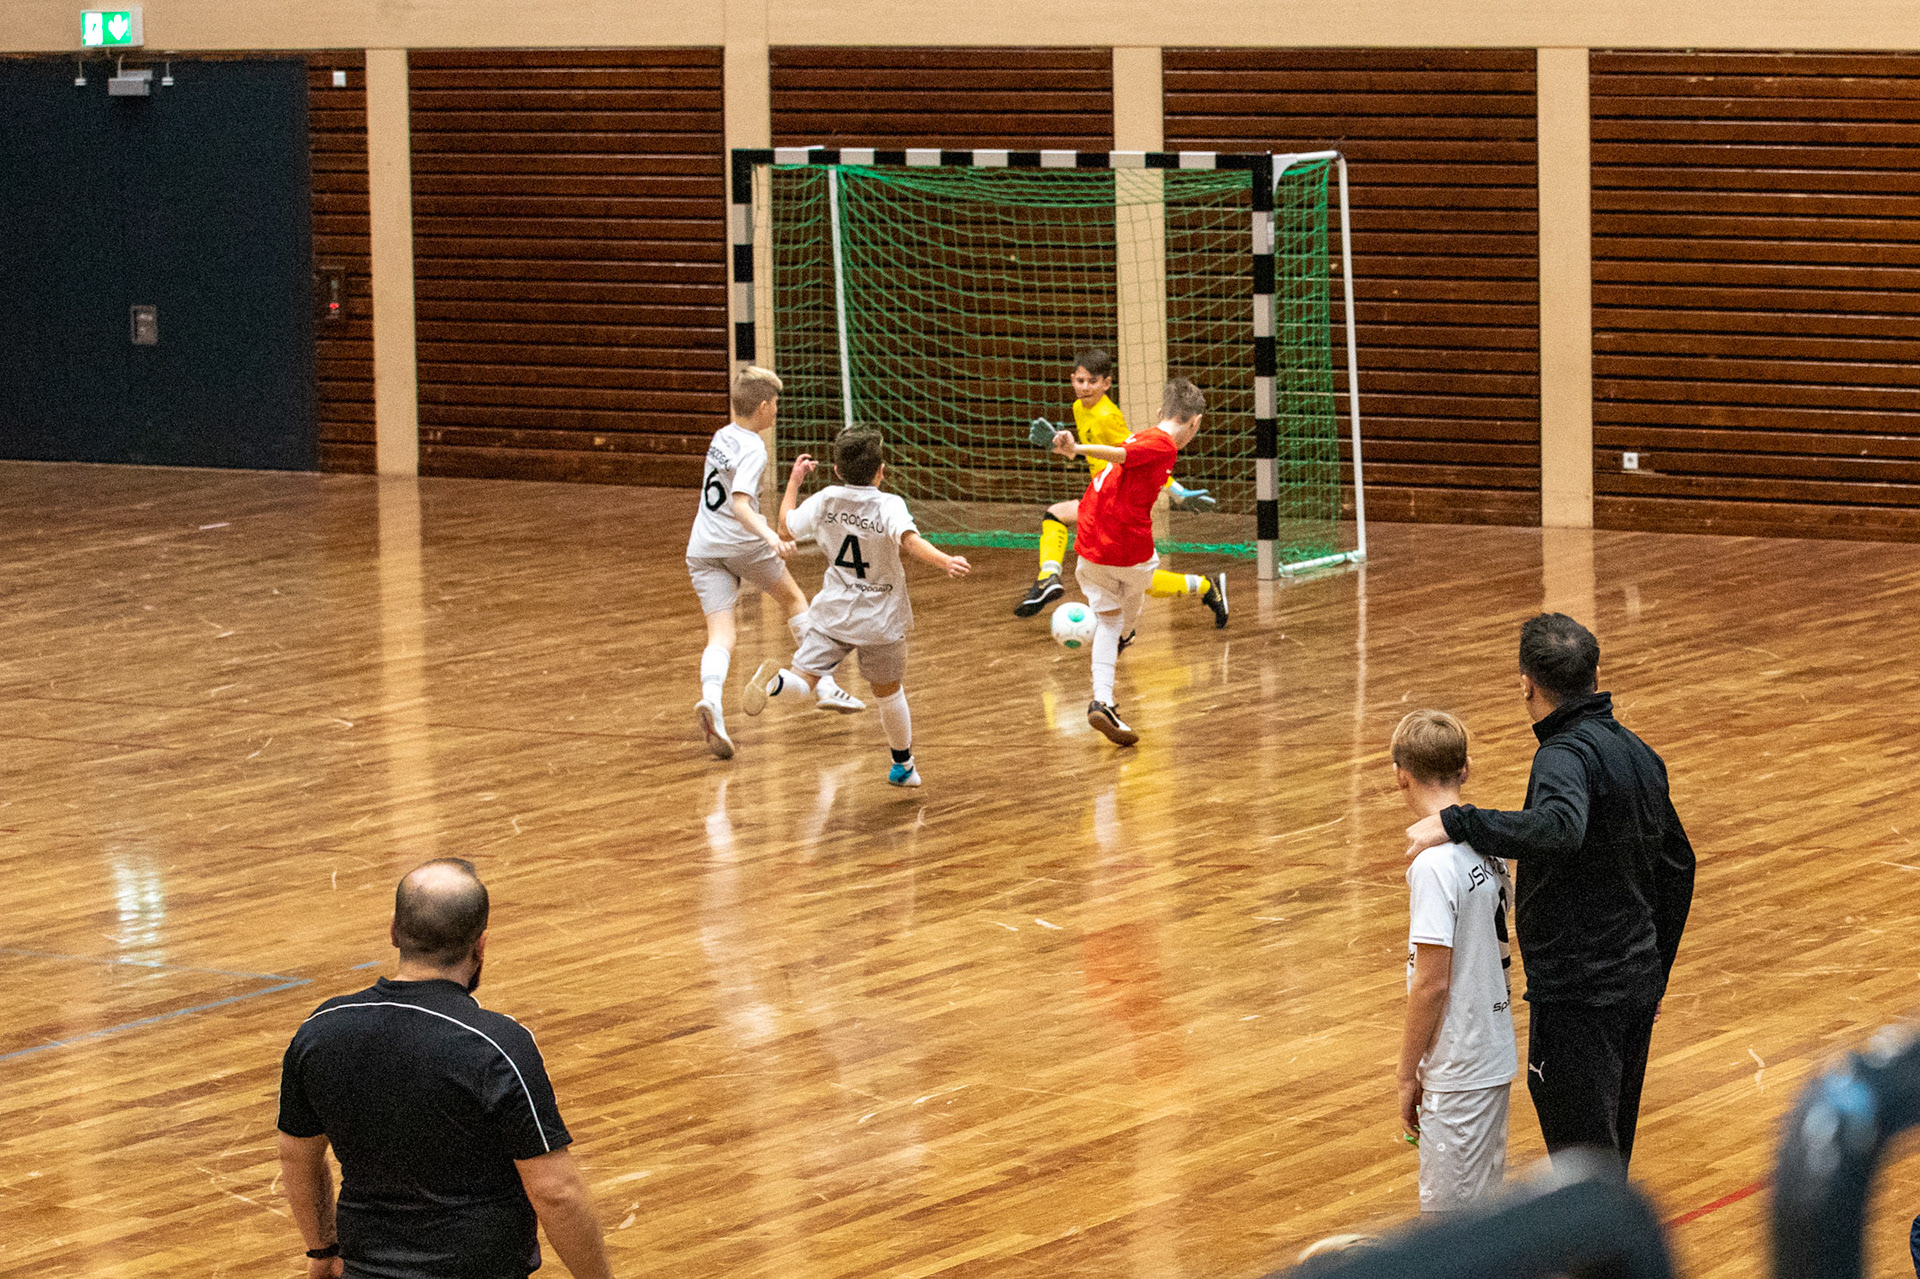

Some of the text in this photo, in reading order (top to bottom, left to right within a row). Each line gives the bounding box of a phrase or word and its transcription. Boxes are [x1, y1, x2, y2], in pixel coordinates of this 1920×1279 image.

[704, 467, 727, 512] 6
[824, 512, 885, 534] SK RODGAU
[834, 534, 870, 579] 4
[1468, 860, 1494, 893] JSK
